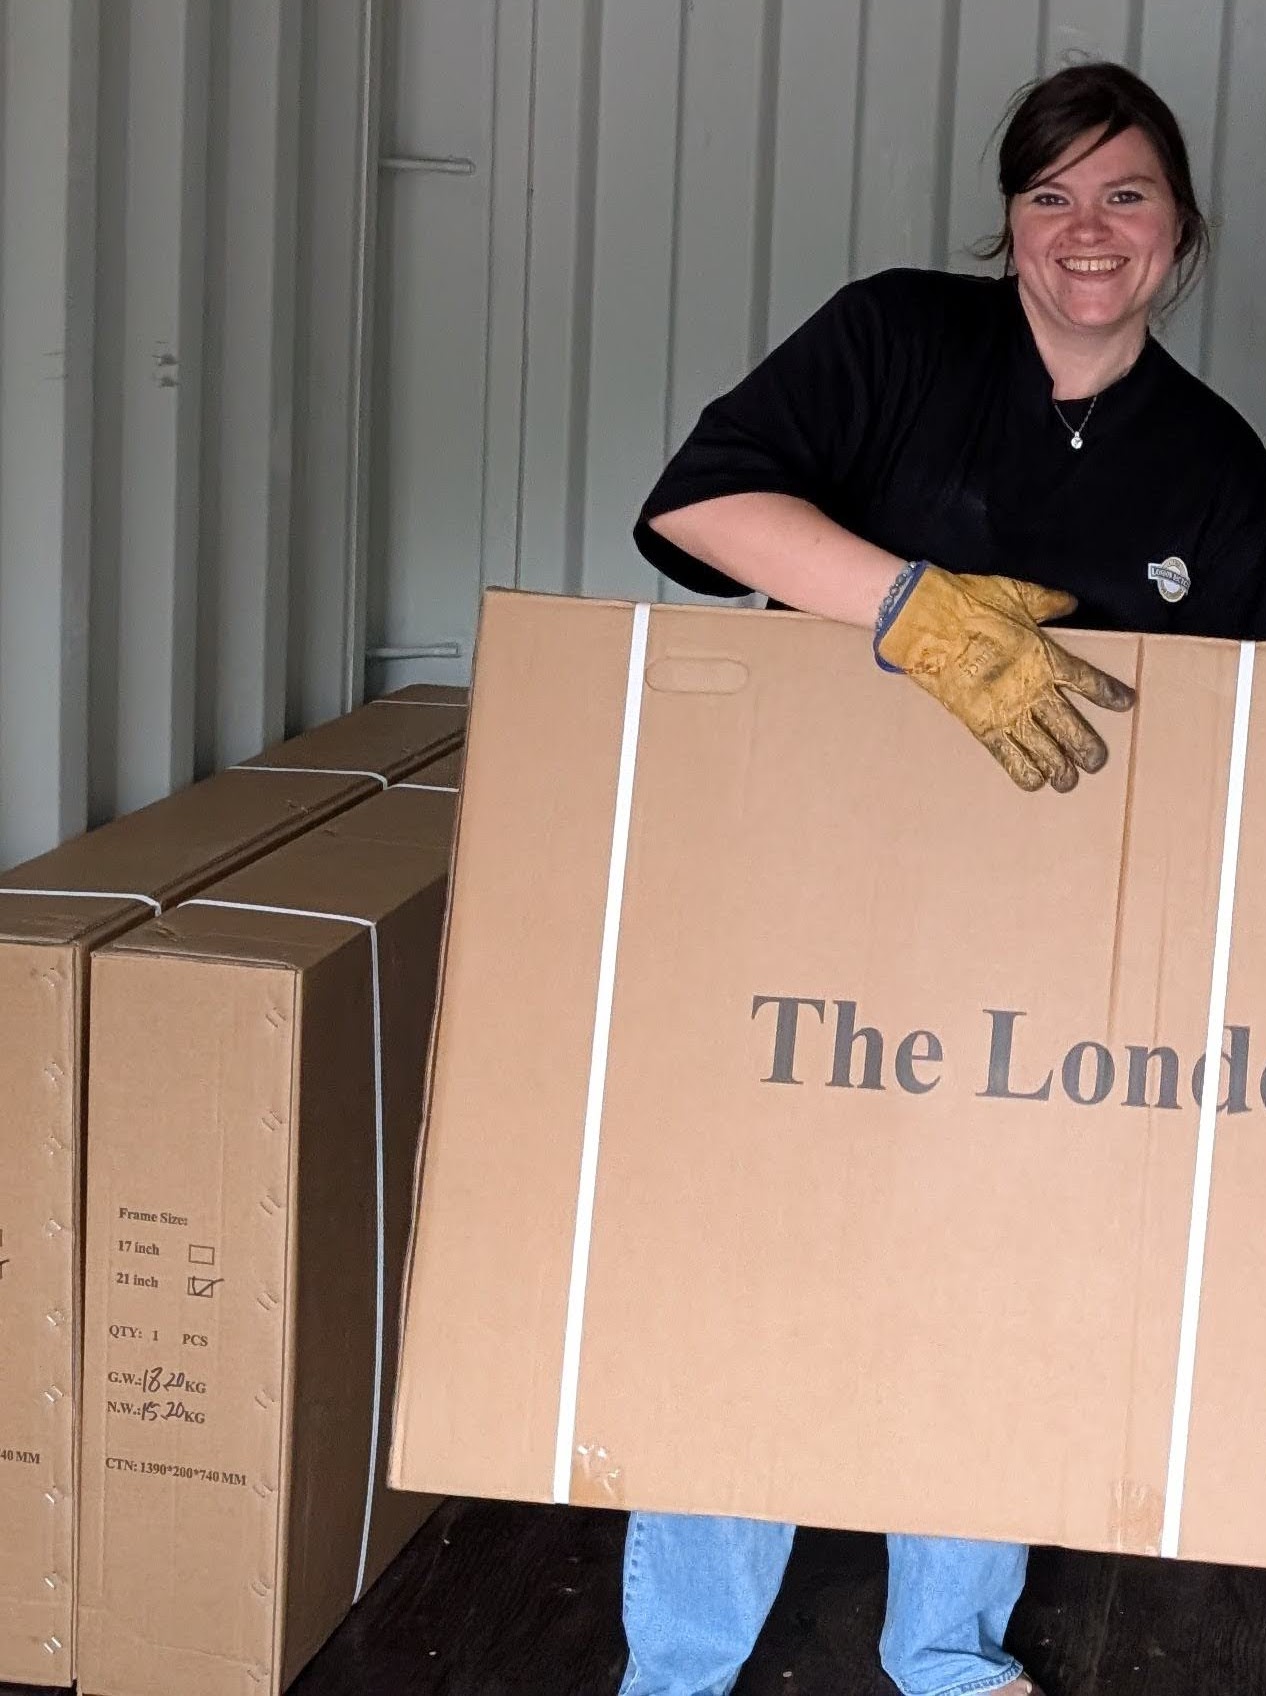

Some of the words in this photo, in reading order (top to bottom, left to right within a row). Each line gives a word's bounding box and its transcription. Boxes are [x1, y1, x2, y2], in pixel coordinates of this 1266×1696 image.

[750, 994, 944, 1095] The
[119, 1207, 158, 1223] Frame
[159, 1212, 188, 1227] Size:
[117, 1240, 132, 1253] 17
[134, 1242, 160, 1256] inch
[116, 1273, 131, 1285] 21
[133, 1275, 159, 1289] inch
[109, 1325, 143, 1340] QTY:
[152, 1330, 159, 1341] 1
[182, 1333, 209, 1347] PCS
[16, 1459, 40, 1477] MM
[105, 1457, 138, 1472] CTN:
[221, 1472, 247, 1486] MM
